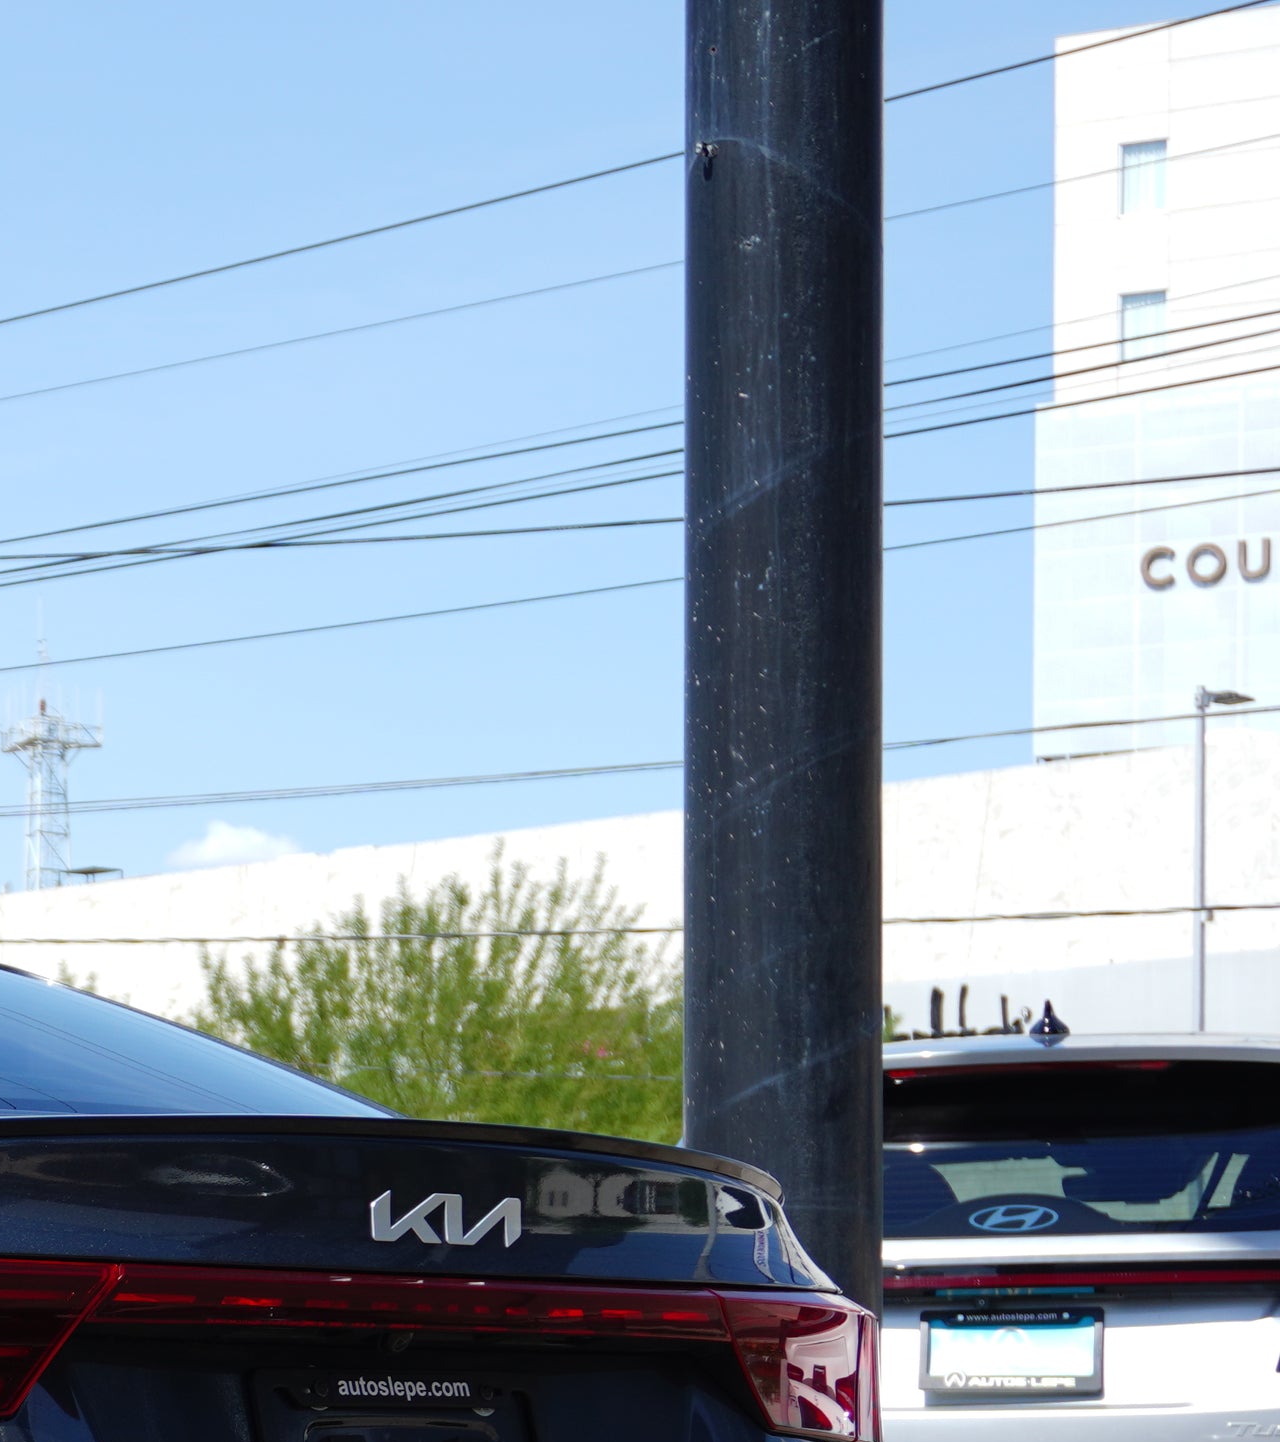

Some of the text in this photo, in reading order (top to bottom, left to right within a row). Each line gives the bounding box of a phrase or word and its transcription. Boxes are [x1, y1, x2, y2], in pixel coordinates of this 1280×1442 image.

[1140, 538, 1271, 591] COU
[370, 1190, 522, 1248] KIA
[966, 1312, 1058, 1323] www.autoslepe.com
[337, 1376, 471, 1402] autoslepe.com
[1227, 1421, 1280, 1437] TU
